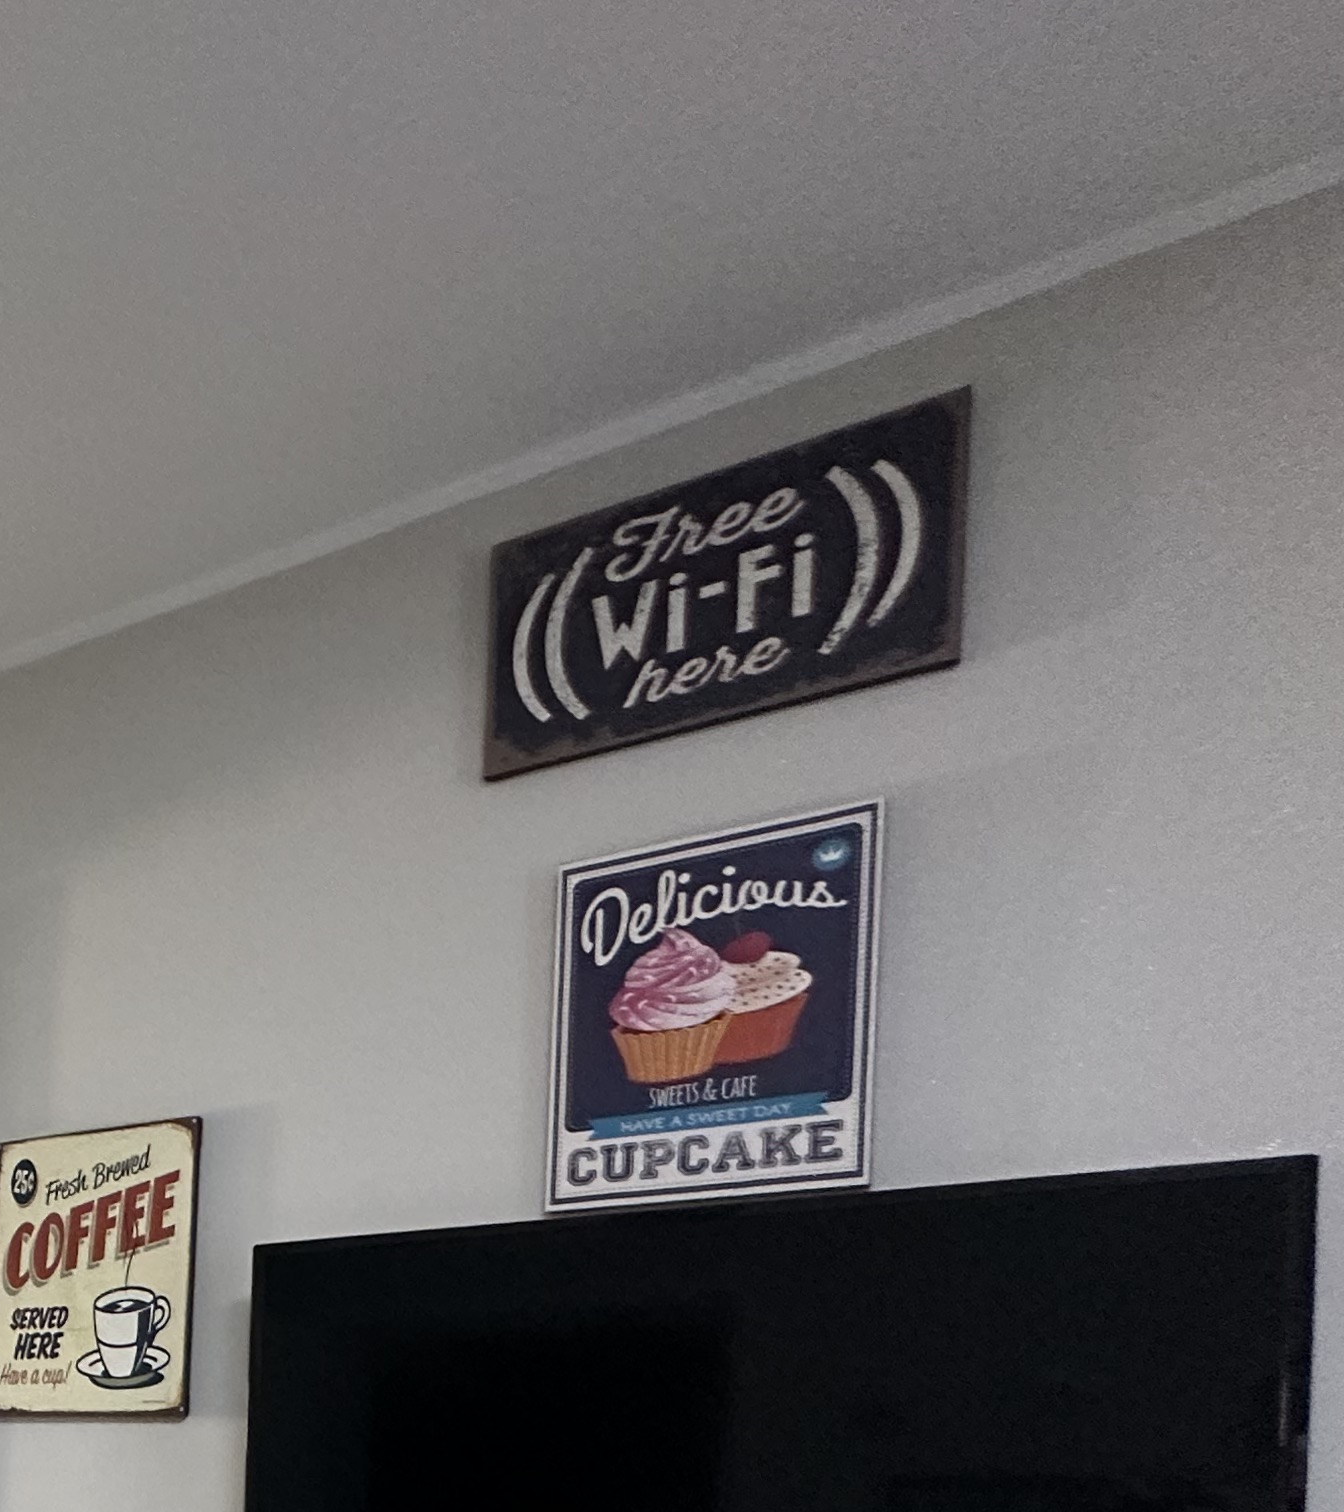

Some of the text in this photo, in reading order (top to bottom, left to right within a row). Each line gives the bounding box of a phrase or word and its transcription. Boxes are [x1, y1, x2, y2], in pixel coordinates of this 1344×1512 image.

[606, 487, 806, 583] Free
[592, 532, 814, 671] Wi-Fi
[623, 636, 791, 709] here
[580, 865, 849, 967] Delicious
[620, 1102, 792, 1133] HAVE A SWEET DAY
[648, 1075, 757, 1109] SWEETS & CAFE
[45, 1145, 151, 1205] Fresh Brewed
[566, 1118, 845, 1187] CUPCAKE
[5, 1169, 181, 1290] COFFEE
[10, 1306, 69, 1331] SERVED
[13, 1332, 64, 1360] HERE
[0, 1362, 29, 1386] Have
[42, 1361, 72, 1392] cup!
